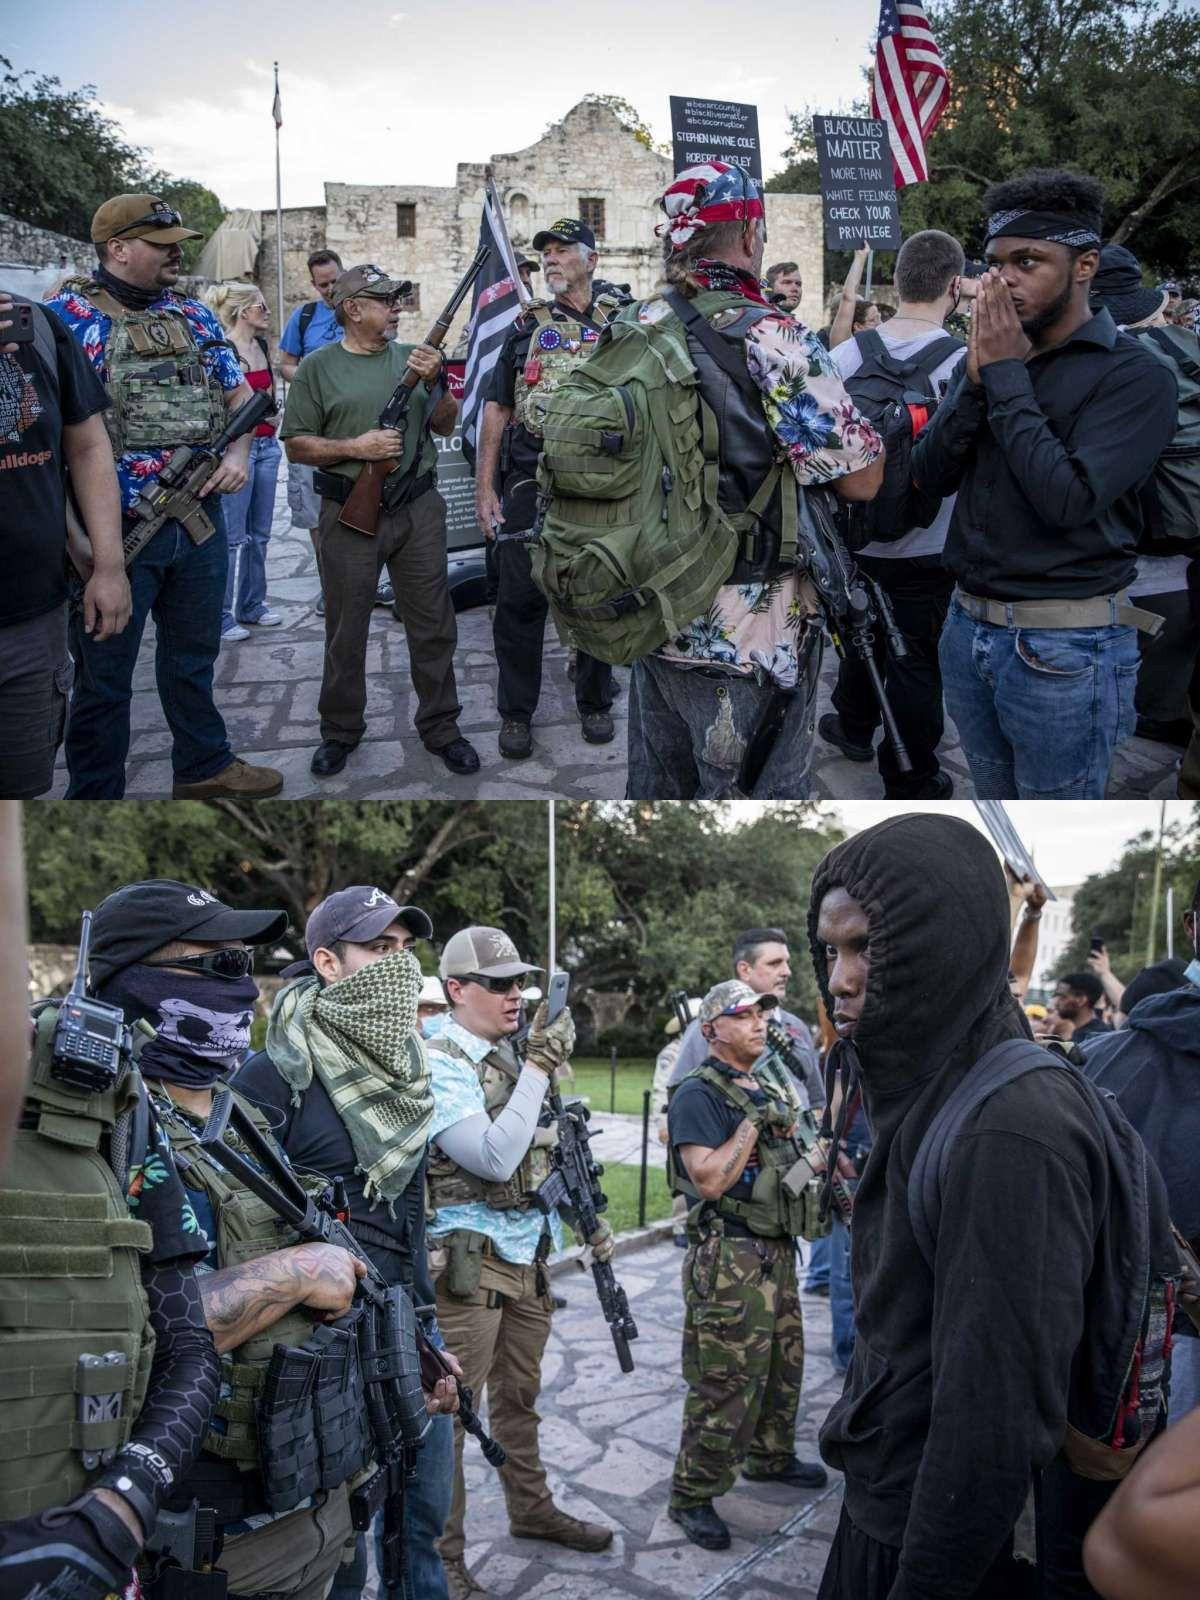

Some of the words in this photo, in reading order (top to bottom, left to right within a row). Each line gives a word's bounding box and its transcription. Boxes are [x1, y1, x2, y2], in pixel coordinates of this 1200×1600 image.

[824, 119, 856, 136] BLACK
[857, 121, 883, 138] LIVES
[676, 131, 709, 144] STEPHEN
[710, 134, 736, 147] WAYNE
[737, 137, 756, 149] COLE
[826, 140, 881, 160] MATTER
[686, 152, 717, 163] ROBERT
[721, 155, 752, 167] MOSLEY
[830, 167, 857, 180] MORE
[858, 167, 882, 180] THAN
[826, 189, 855, 201] WHITE
[859, 190, 897, 202] FEELINGS
[830, 206, 860, 220] CHECK
[865, 206, 892, 220] YOUR
[839, 225, 892, 240] PRIVILEGE
